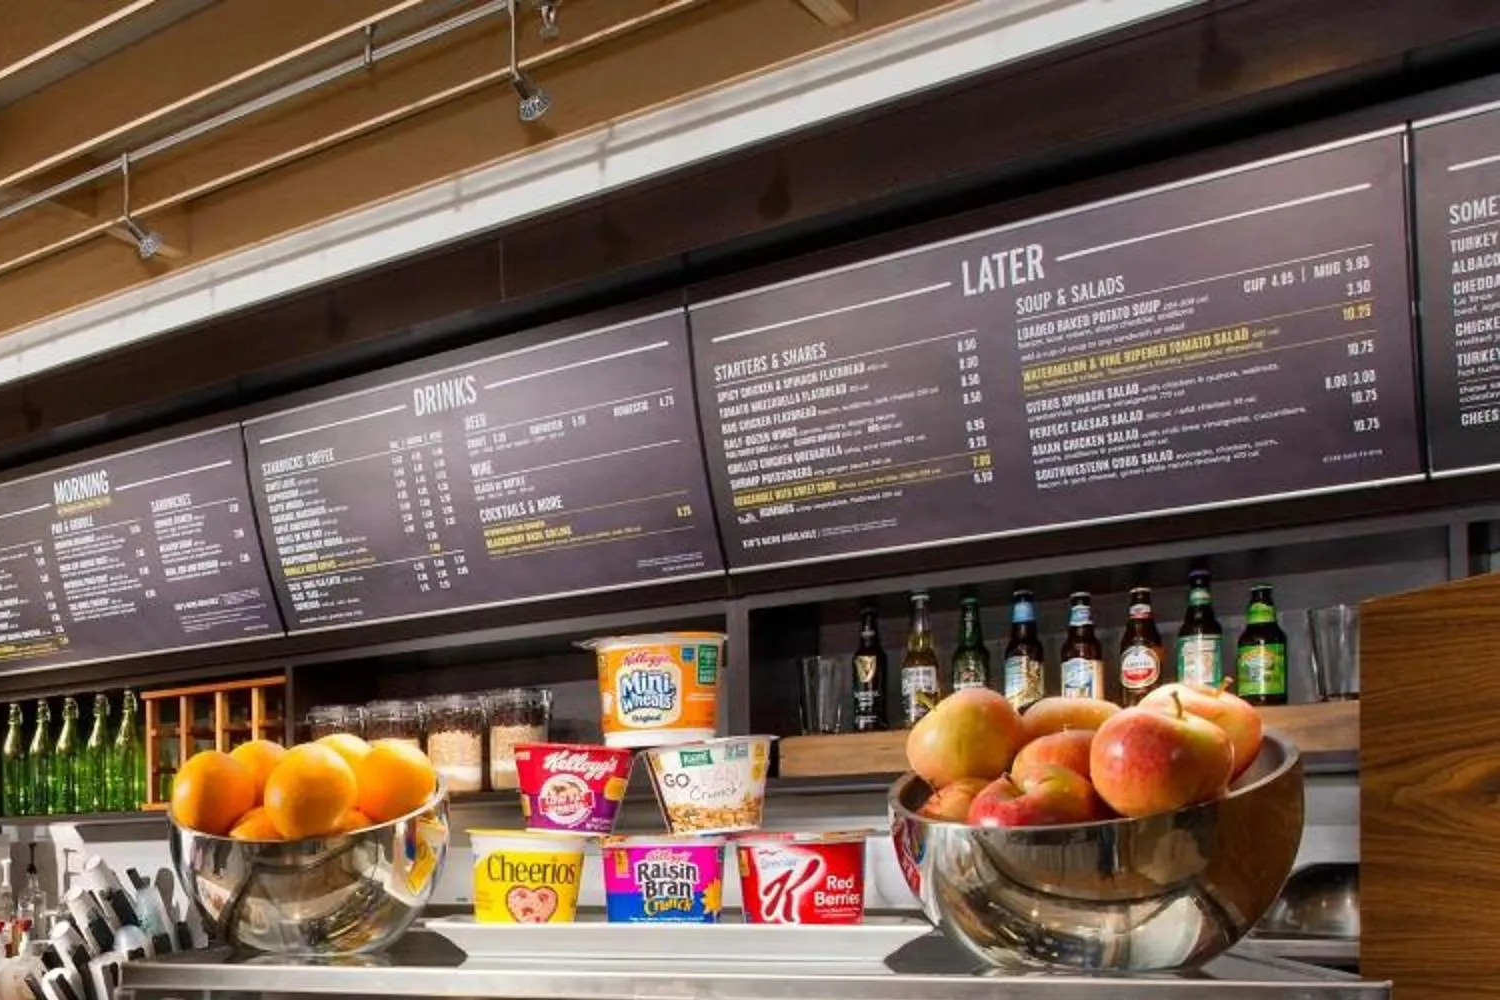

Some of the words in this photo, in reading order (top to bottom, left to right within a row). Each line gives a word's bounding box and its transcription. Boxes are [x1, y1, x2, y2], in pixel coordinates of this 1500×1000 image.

[1450, 195, 1500, 225] SOME
[1451, 231, 1498, 253] TURKEY
[961, 243, 1045, 297] LATER
[1243, 277, 1266, 293] CUP
[1313, 261, 1341, 278] MUG
[1015, 292, 1052, 315] SOUP
[1056, 288, 1066, 305] &
[1071, 275, 1125, 303] SALADS
[1017, 321, 1054, 341] LOADED
[1057, 314, 1090, 333] BAKED
[1092, 305, 1130, 325] POTATO
[1132, 299, 1161, 315] SOUP
[1169, 335, 1211, 354] TOMATO
[1213, 326, 1249, 346] SALAD
[714, 355, 767, 381] STARTERS
[783, 342, 827, 366] SHARES
[740, 382, 774, 399] CHICKEN
[819, 362, 866, 382] FLATBREAD
[802, 384, 847, 402] FLATBREAD
[413, 375, 477, 417] DRINKS
[1062, 390, 1105, 409] SPINACH
[1106, 383, 1139, 400] SALAD
[773, 405, 817, 425] FLATBREAD
[1029, 424, 1068, 440] PERFECT
[1071, 418, 1108, 433] CAESAR
[1111, 410, 1143, 426] SALAD
[1461, 408, 1500, 426] CHEES
[1032, 441, 1061, 456] ASIAN
[1063, 434, 1105, 450] CHICKEN
[1107, 428, 1139, 444] SALAD
[1035, 459, 1110, 481] SOUTHWESTERN
[1140, 449, 1173, 464] SALAD
[53, 469, 110, 504] MORNING
[479, 501, 525, 523] COCKTAILS
[537, 495, 564, 512] MORE
[620, 692, 673, 713] Wheats
[542, 750, 618, 781] Kellogg's
[663, 773, 690, 788] GO
[487, 854, 576, 884] Cheerios
[637, 862, 697, 882] Raisin
[827, 874, 854, 889] Red
[644, 880, 691, 899] Bran
[814, 891, 861, 907] Berries
[644, 898, 693, 916] Crunch
